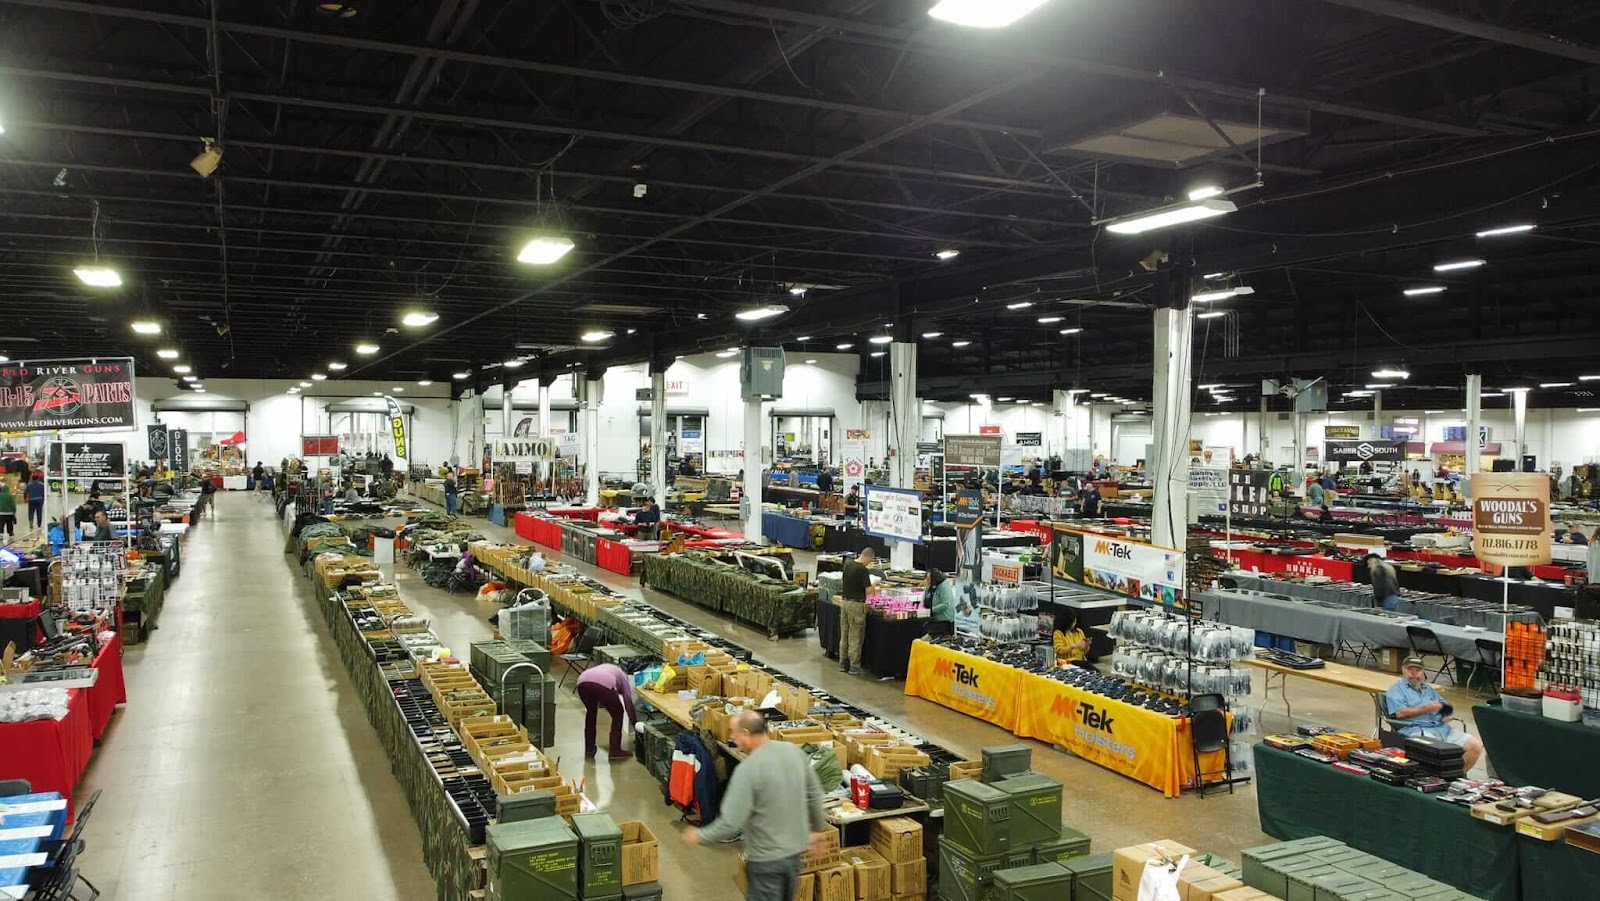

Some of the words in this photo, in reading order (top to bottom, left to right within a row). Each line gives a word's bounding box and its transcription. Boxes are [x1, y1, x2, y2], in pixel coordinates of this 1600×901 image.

[2, 367, 29, 377] RED
[36, 366, 77, 375] RIVER
[83, 364, 121, 374] GUNS
[666, 381, 683, 389] EXIT
[0, 385, 34, 408] R-15
[82, 381, 132, 405] PARTS
[0, 416, 123, 428] WWW.REDRIVERGUNS.COM
[500, 442, 548, 456] AMMO
[1333, 447, 1357, 455] SABER
[1374, 446, 1398, 454] SOUTH
[1232, 503, 1267, 516] SHOP
[1480, 500, 1538, 513] WOODAL'S
[1493, 512, 1523, 525] GUNS
[1481, 537, 1538, 550] 717.816.1778
[993, 567, 1018, 580] TUCKABLE
[1286, 563, 1324, 576] BUNKER
[950, 683, 996, 709] Holsters
[1074, 723, 1136, 760] Holsters
